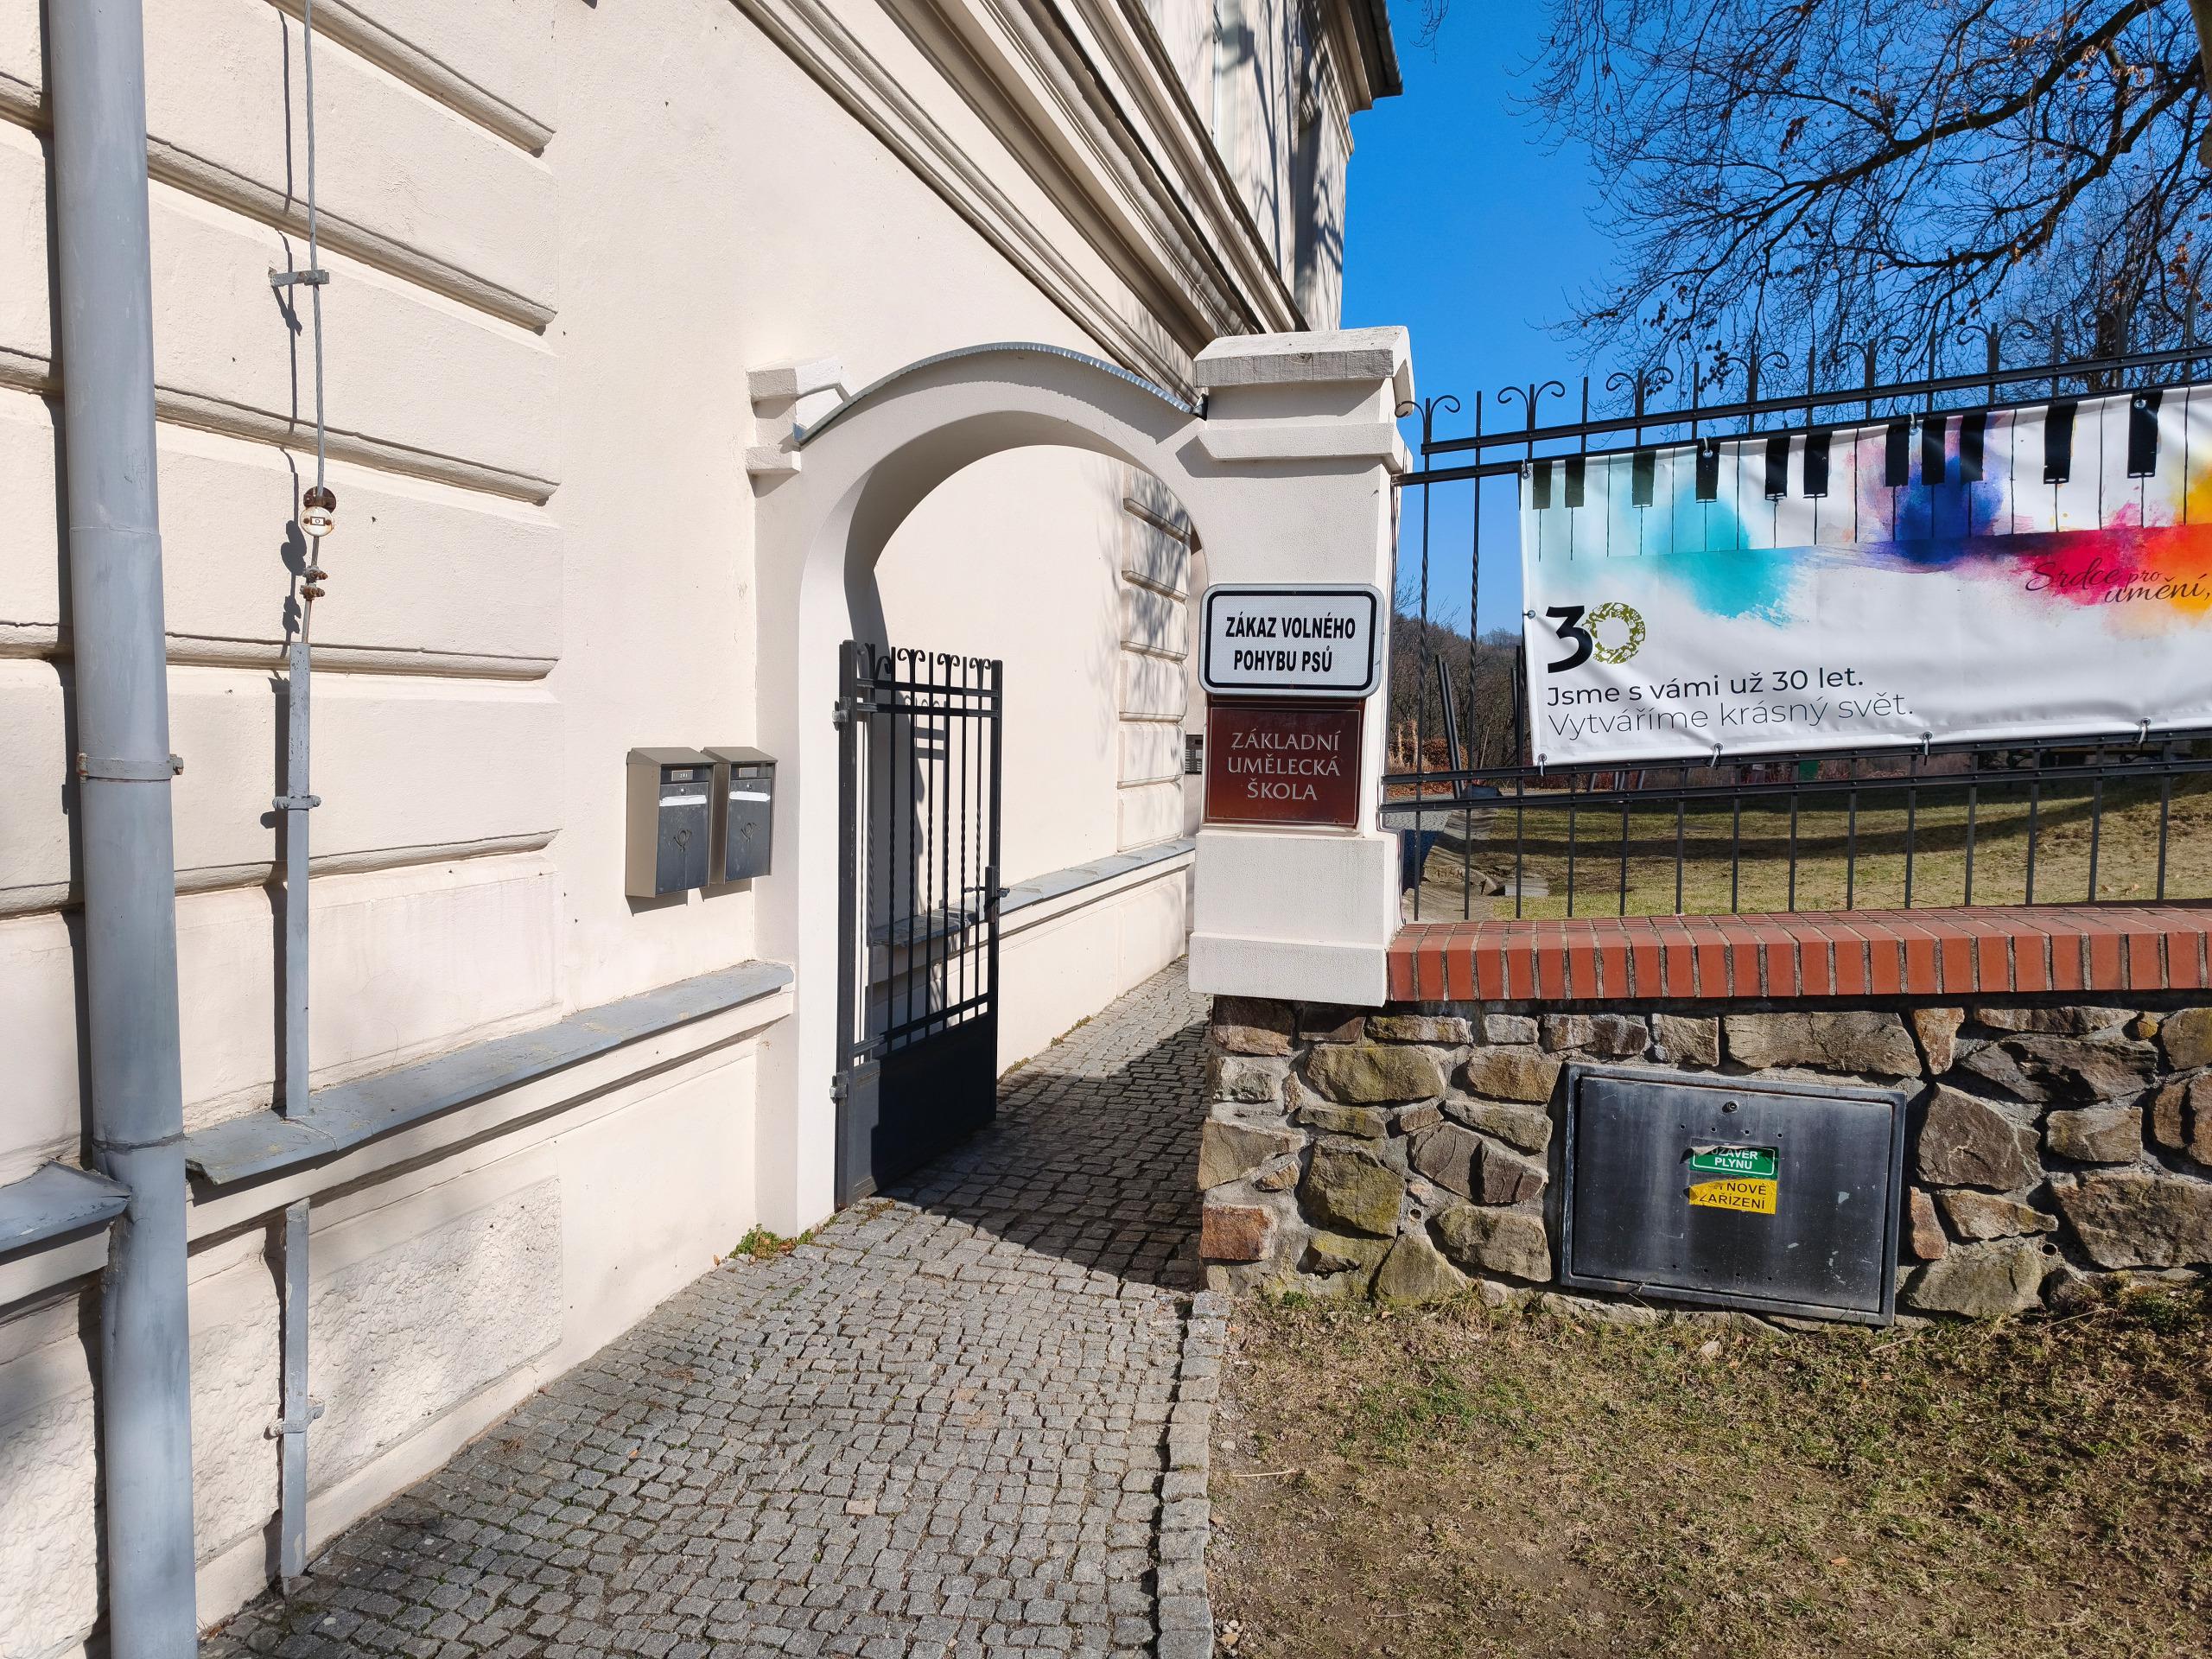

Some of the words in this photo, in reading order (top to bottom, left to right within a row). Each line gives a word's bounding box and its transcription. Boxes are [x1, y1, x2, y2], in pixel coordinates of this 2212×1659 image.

[2025, 557, 2120, 591] Srdce
[2126, 569, 2161, 592] pro
[2105, 574, 2211, 603] umění,
[1225, 612, 1276, 638] ZÁKAZ
[1282, 613, 1356, 639] VOLNÉHO
[1546, 602, 1645, 674] 30
[1234, 650, 1297, 671] POHYBU
[1302, 645, 1332, 672] PSŮ
[1548, 687, 1620, 707] Jsme
[1629, 687, 1643, 701] s
[1649, 674, 1719, 699] vámi
[1730, 671, 1764, 694] už
[1772, 670, 1808, 690] 30
[1819, 667, 1864, 688] let.
[1548, 707, 1708, 741] Vytváříme
[1720, 696, 1828, 727] krásný
[1839, 692, 1914, 719] svět.
[1230, 728, 1341, 751] ZÁKLADNÍ
[1228, 754, 1340, 776] UMĚLECKÁ
[1247, 779, 1318, 800] ŠKOLA
[1714, 1157, 1752, 1170] PLYNU
